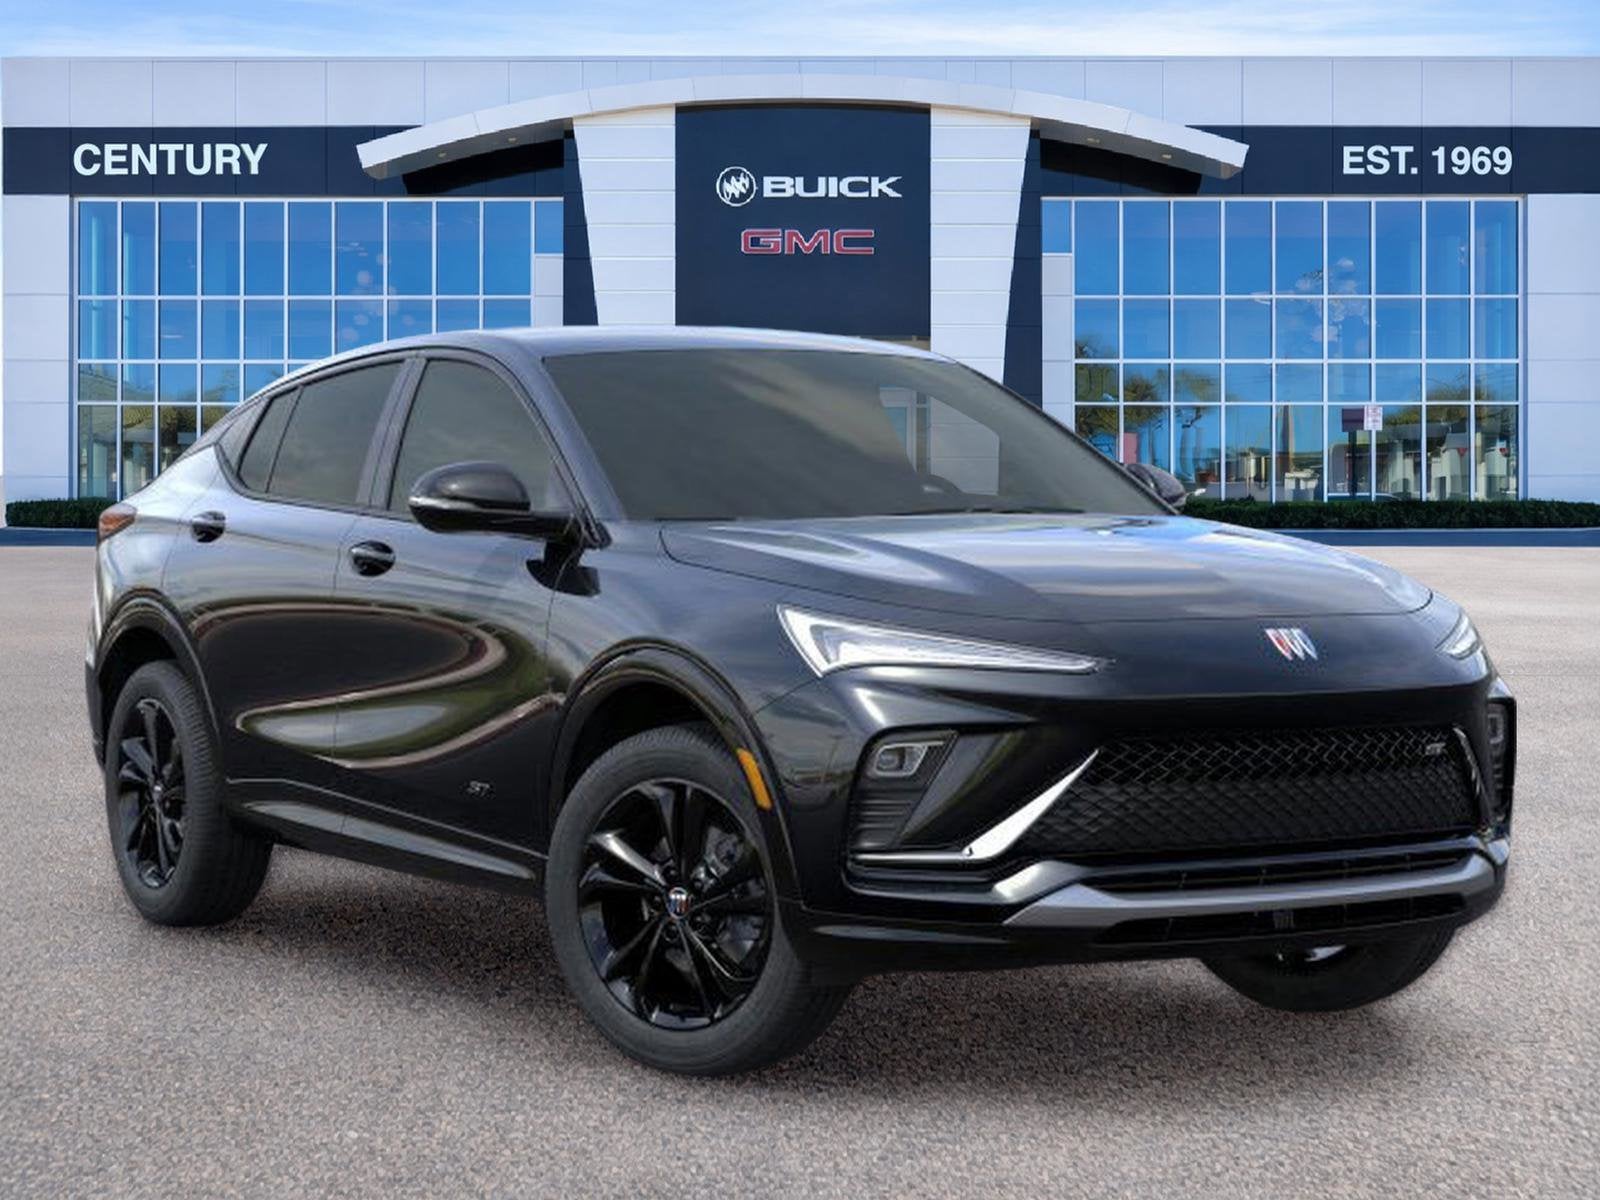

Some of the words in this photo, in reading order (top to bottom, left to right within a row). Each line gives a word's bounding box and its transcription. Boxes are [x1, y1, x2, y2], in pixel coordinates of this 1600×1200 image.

[72, 142, 268, 176] CENTURY
[1342, 145, 1418, 175] EST.
[1431, 145, 1513, 176] 1969
[762, 176, 903, 198] BUICK
[740, 228, 876, 255] GMC
